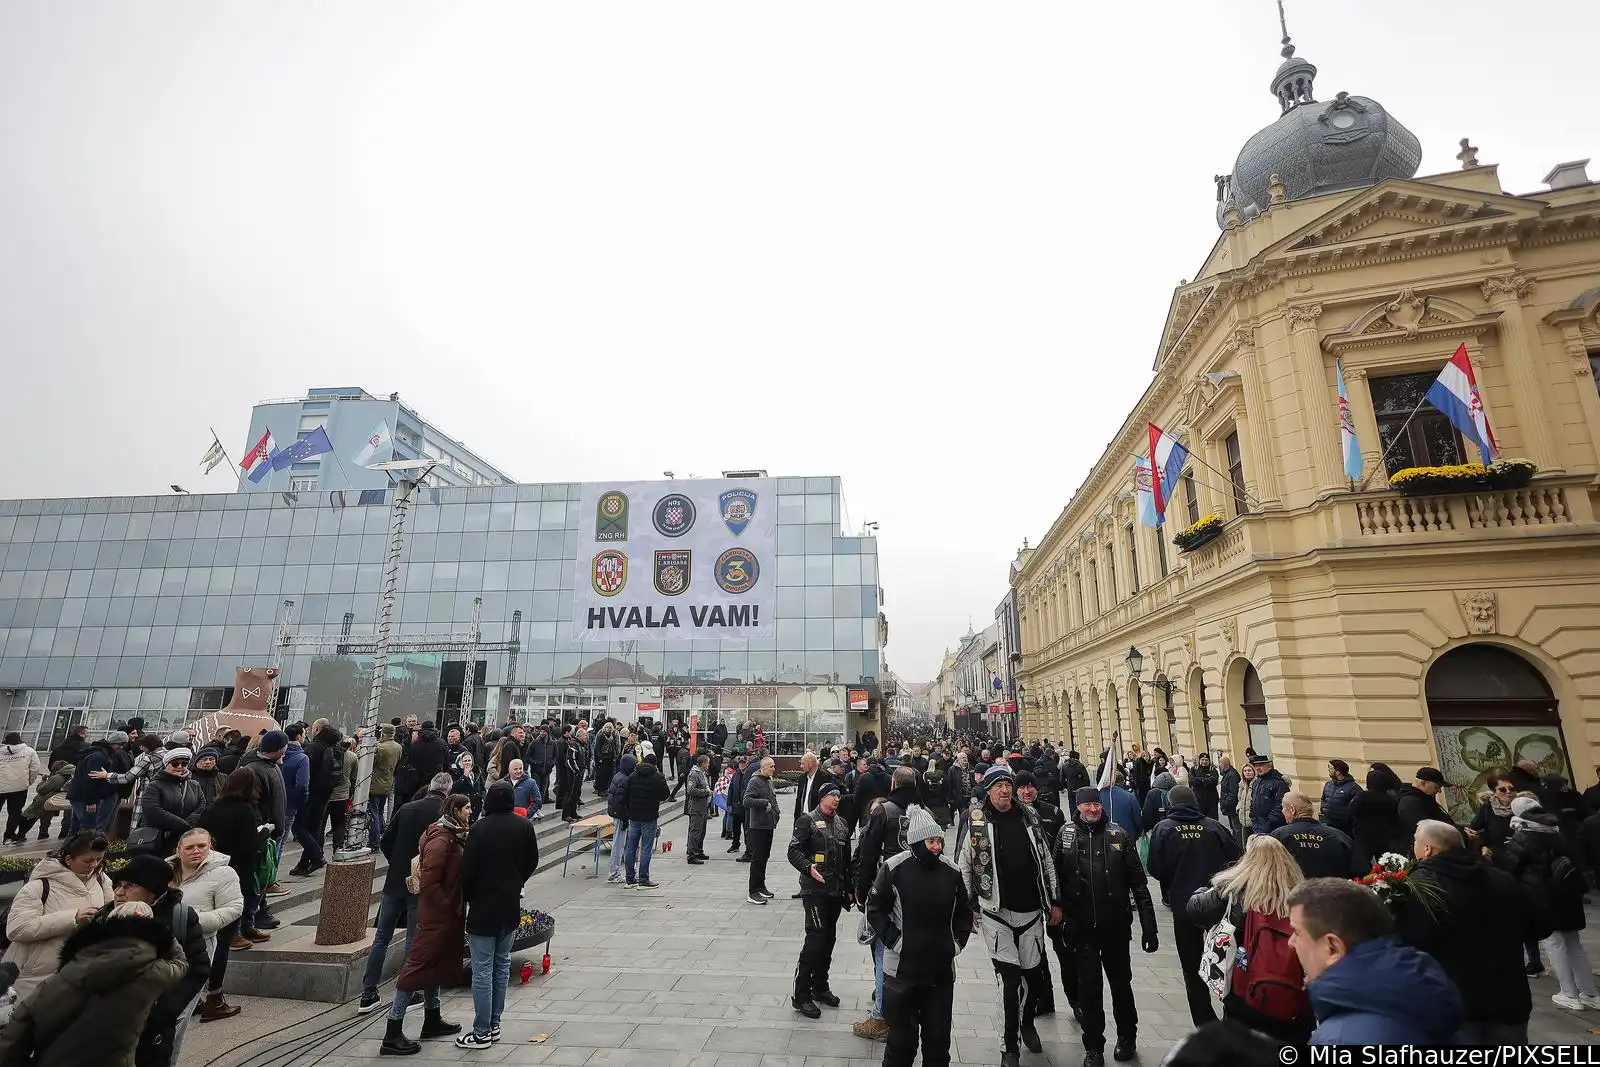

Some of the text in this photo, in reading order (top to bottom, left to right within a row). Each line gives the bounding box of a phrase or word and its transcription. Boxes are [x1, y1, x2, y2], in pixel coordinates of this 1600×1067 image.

[721, 491, 755, 501] POLICIJA
[598, 532, 613, 540] ZNG
[725, 560, 746, 582] 3
[587, 604, 759, 629] HVALA VAM!
[1174, 824, 1204, 832] UNRO
[1293, 833, 1324, 842] UNRO
[1300, 841, 1320, 849] HVO
